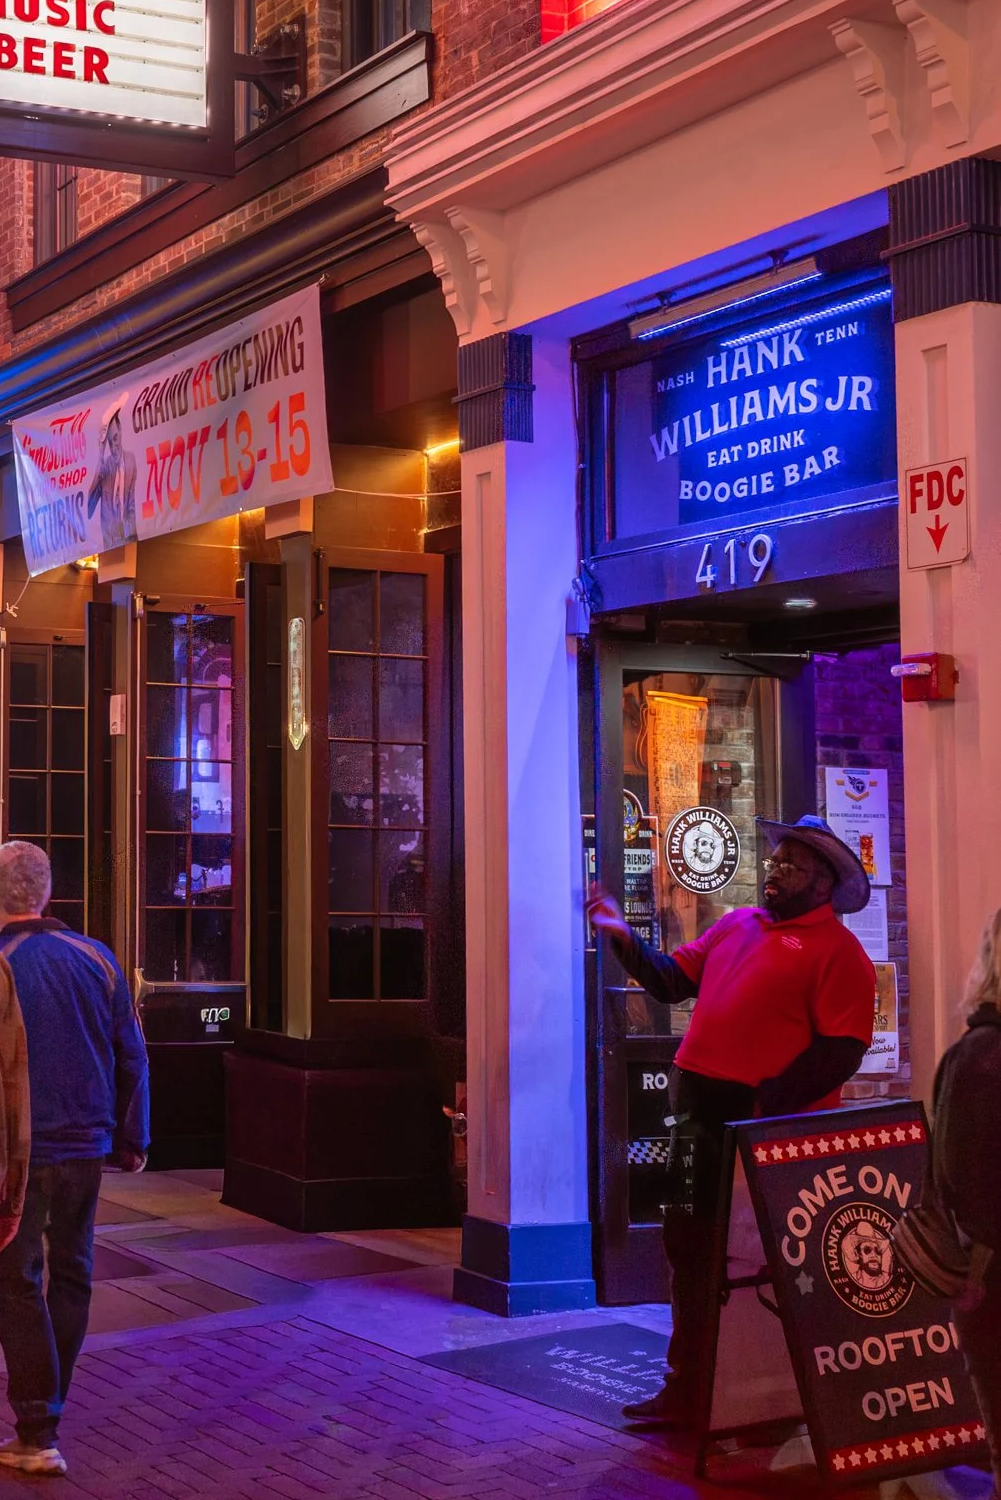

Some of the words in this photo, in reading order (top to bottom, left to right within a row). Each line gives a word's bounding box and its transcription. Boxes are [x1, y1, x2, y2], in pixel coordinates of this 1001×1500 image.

[132, 367, 194, 434] GRAND
[192, 315, 305, 412] REOPENING
[706, 329, 805, 389] HANK
[815, 321, 859, 346] TENN
[657, 371, 694, 393] NASH
[649, 378, 818, 463] WILLIAMS
[825, 376, 874, 412] JR
[141, 425, 212, 519] NOV
[216, 391, 311, 498] 13-15
[707, 444, 742, 468] EAT
[747, 429, 805, 460] DRINK
[59, 467, 88, 490] SHOP
[679, 470, 774, 503] BOOGIE
[784, 445, 841, 488] BAR
[909, 465, 965, 514] FDC
[27, 490, 86, 560] RETURNS
[695, 533, 773, 589] 419
[639, 830, 652, 838] DRINK
[671, 820, 688, 854] HANK
[686, 811, 732, 839] WILLIAMS
[727, 841, 735, 856] JR
[624, 853, 651, 866] FRIENDS
[681, 873, 710, 889] BOOGIE
[710, 874, 727, 888] BAR
[688, 871, 699, 881] EAT
[700, 873, 719, 882] DRINK
[781, 1164, 854, 1266] COME
[858, 1165, 911, 1208] ON
[828, 1224, 842, 1271] HANK
[837, 1207, 893, 1236] WILLIAM
[851, 1294, 889, 1312] BOOGIE
[889, 1286, 907, 1307] BAR
[859, 1291, 873, 1301] EAT
[874, 1287, 895, 1302] DRINK
[862, 1377, 955, 1421] OPEN
